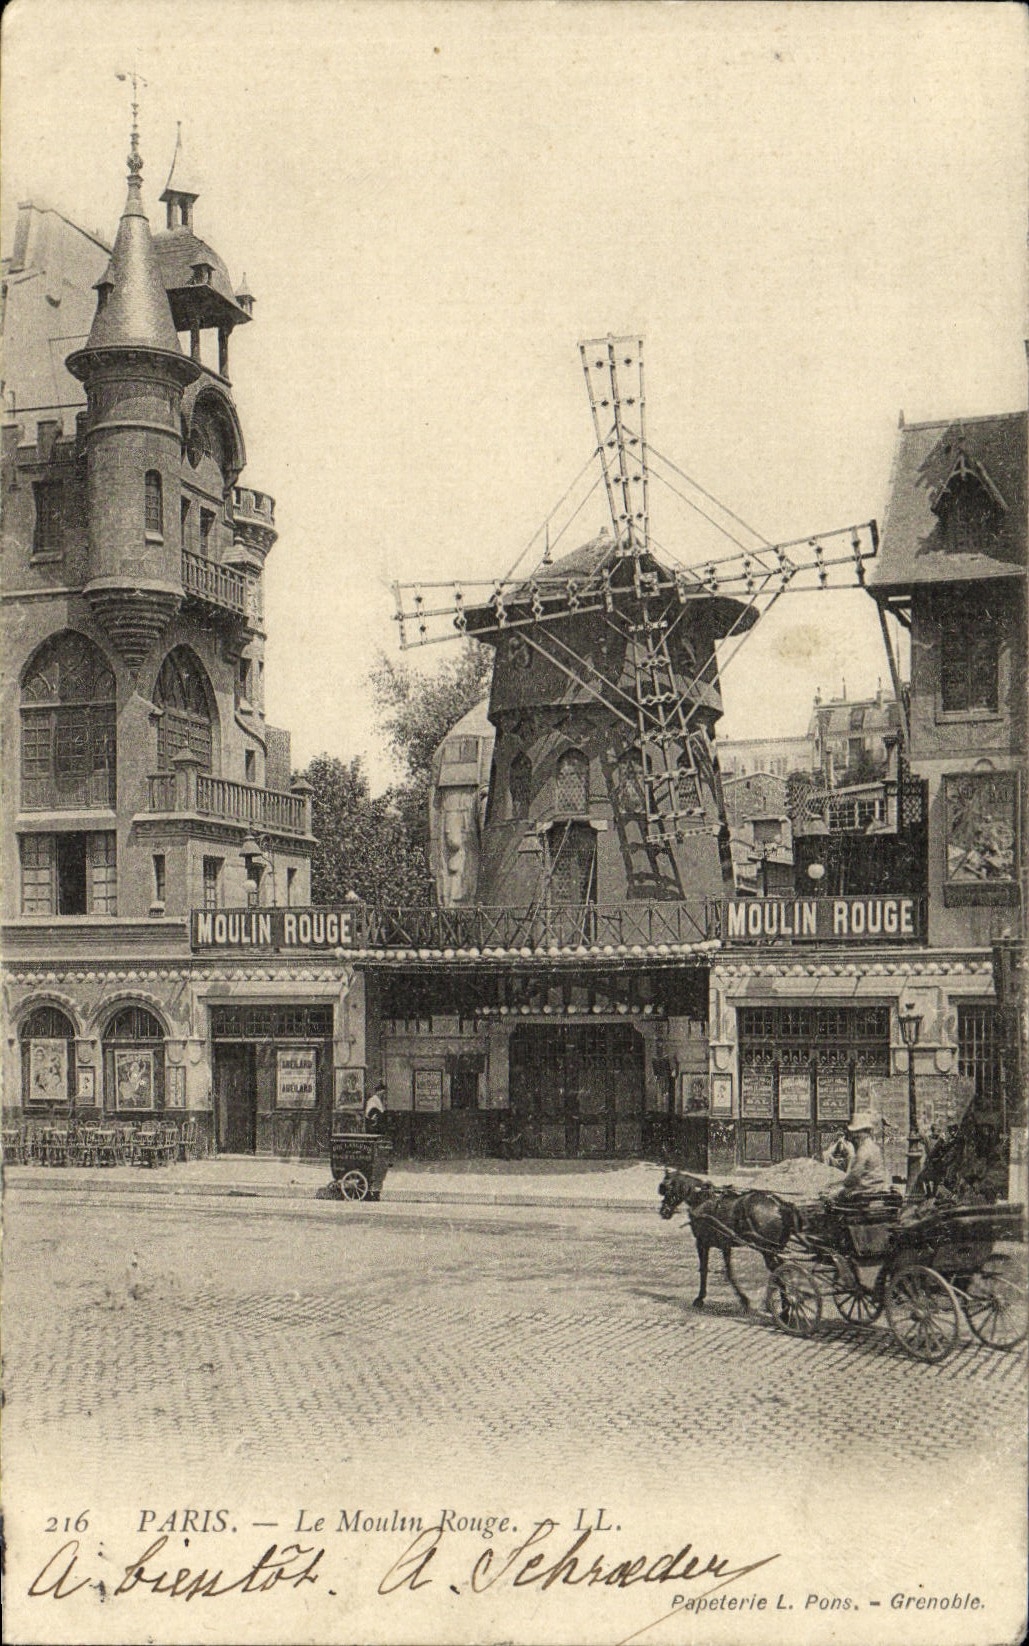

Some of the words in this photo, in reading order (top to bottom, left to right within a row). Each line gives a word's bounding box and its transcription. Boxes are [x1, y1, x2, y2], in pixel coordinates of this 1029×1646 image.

[196, 913, 272, 944] MOULIN
[283, 913, 353, 944] ROUGE
[725, 901, 818, 936] MOULIN
[833, 900, 915, 934] ROUGE
